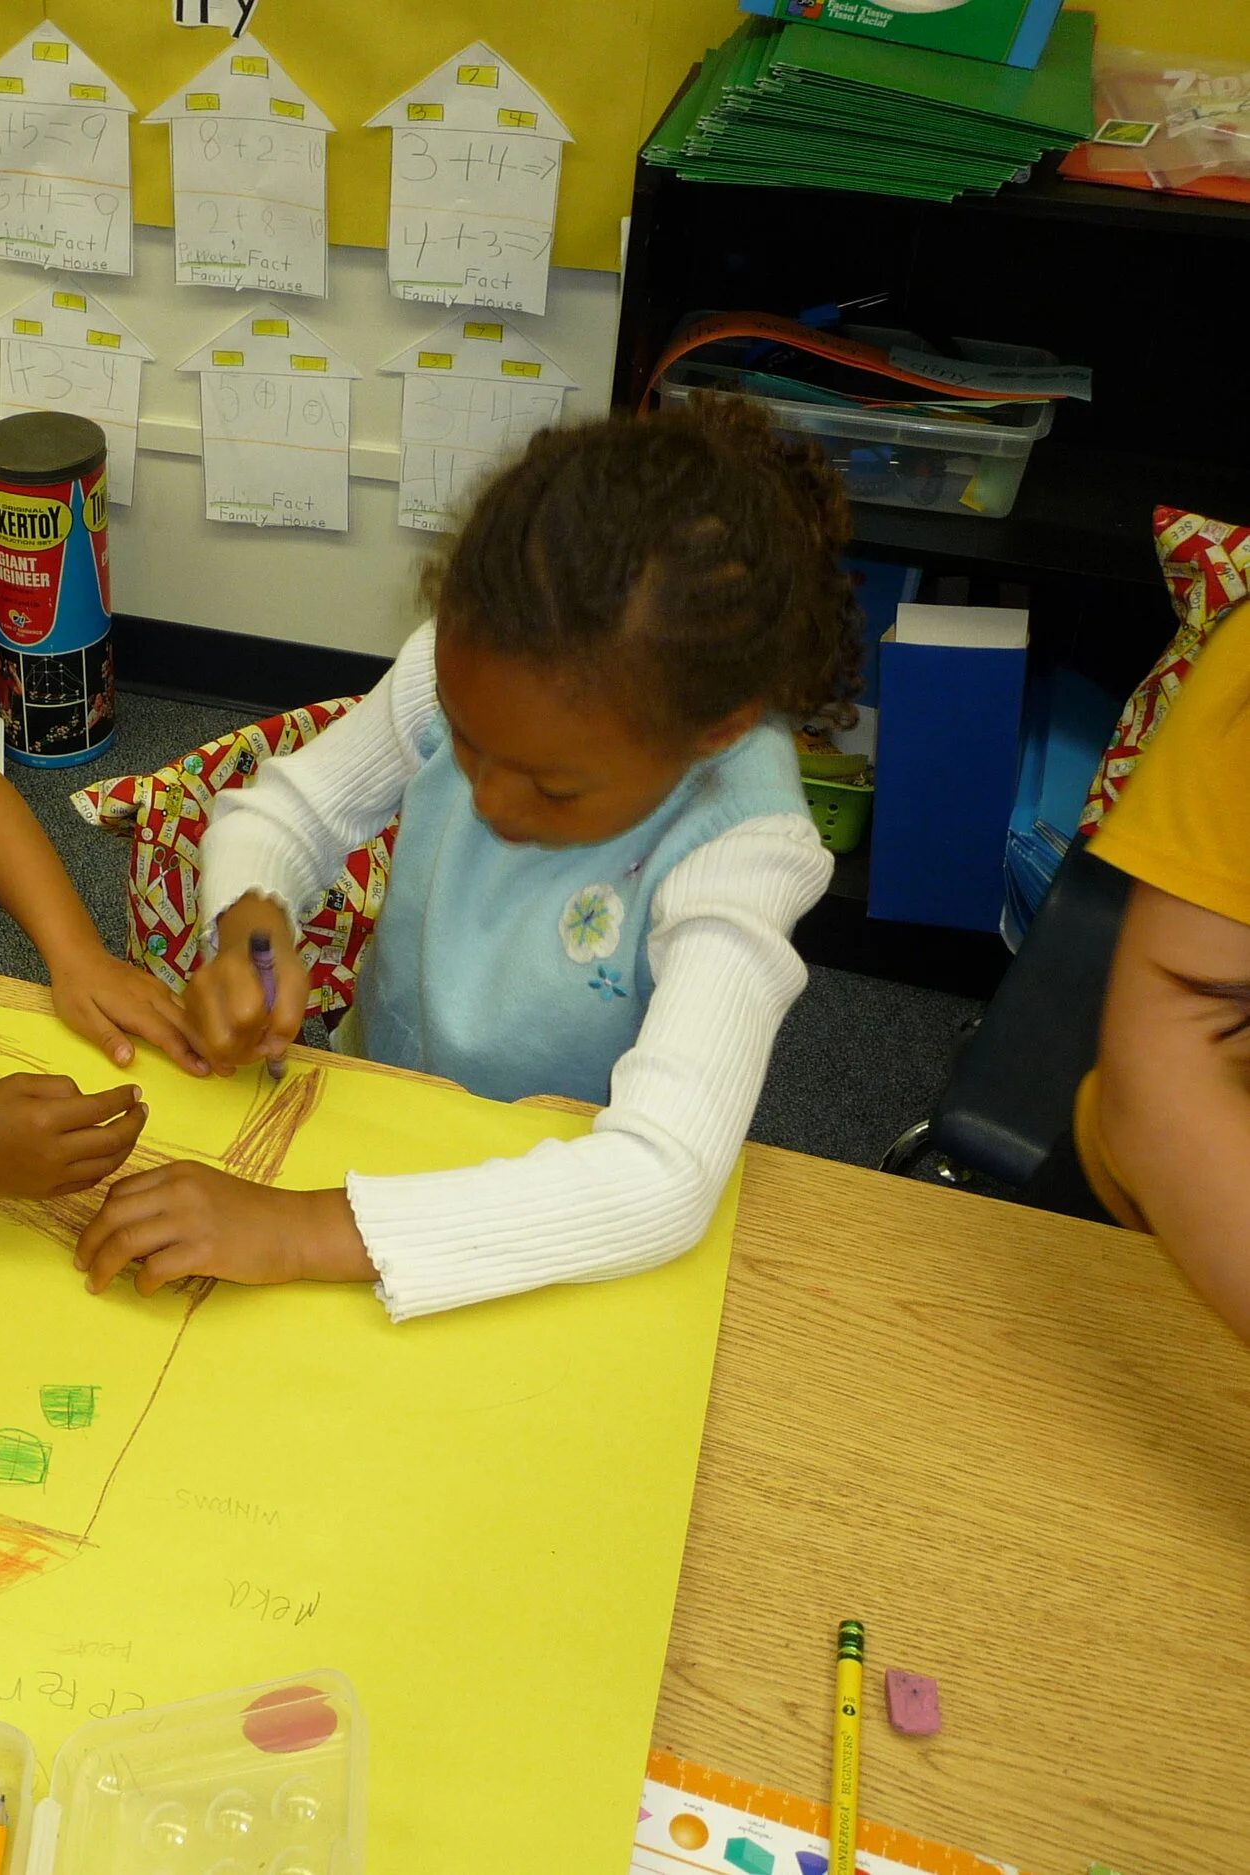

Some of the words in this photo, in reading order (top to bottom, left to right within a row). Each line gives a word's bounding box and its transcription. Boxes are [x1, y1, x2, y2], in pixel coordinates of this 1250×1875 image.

[829, 8, 855, 21] Tissu
[857, 14, 888, 28] Facial
[861, 6, 894, 20] Tissue
[467, 67, 480, 83] 7
[413, 104, 427, 119] 3
[509, 112, 524, 127] 4
[54, 230, 96, 252] Fact
[5, 242, 51, 265] Family
[62, 255, 108, 271] House
[248, 250, 292, 273] Fact
[190, 266, 244, 289] Family
[257, 276, 303, 293] House
[464, 267, 513, 291] Fact
[402, 285, 458, 308] Family
[473, 292, 523, 312] House
[3, 503, 44, 513] ORIGINAL
[272, 491, 315, 511] Fact
[219, 506, 269, 527] Family
[282, 514, 327, 528] House
[1171, 520, 1193, 541] SEE
[296, 710, 313, 734] SPOT
[215, 755, 237, 783] DICK
[195, 784, 210, 803] BUS
[371, 880, 383, 901] ABC
[158, 965, 177, 985] BUS
[841, 1734, 854, 1796] BEGINNERS
